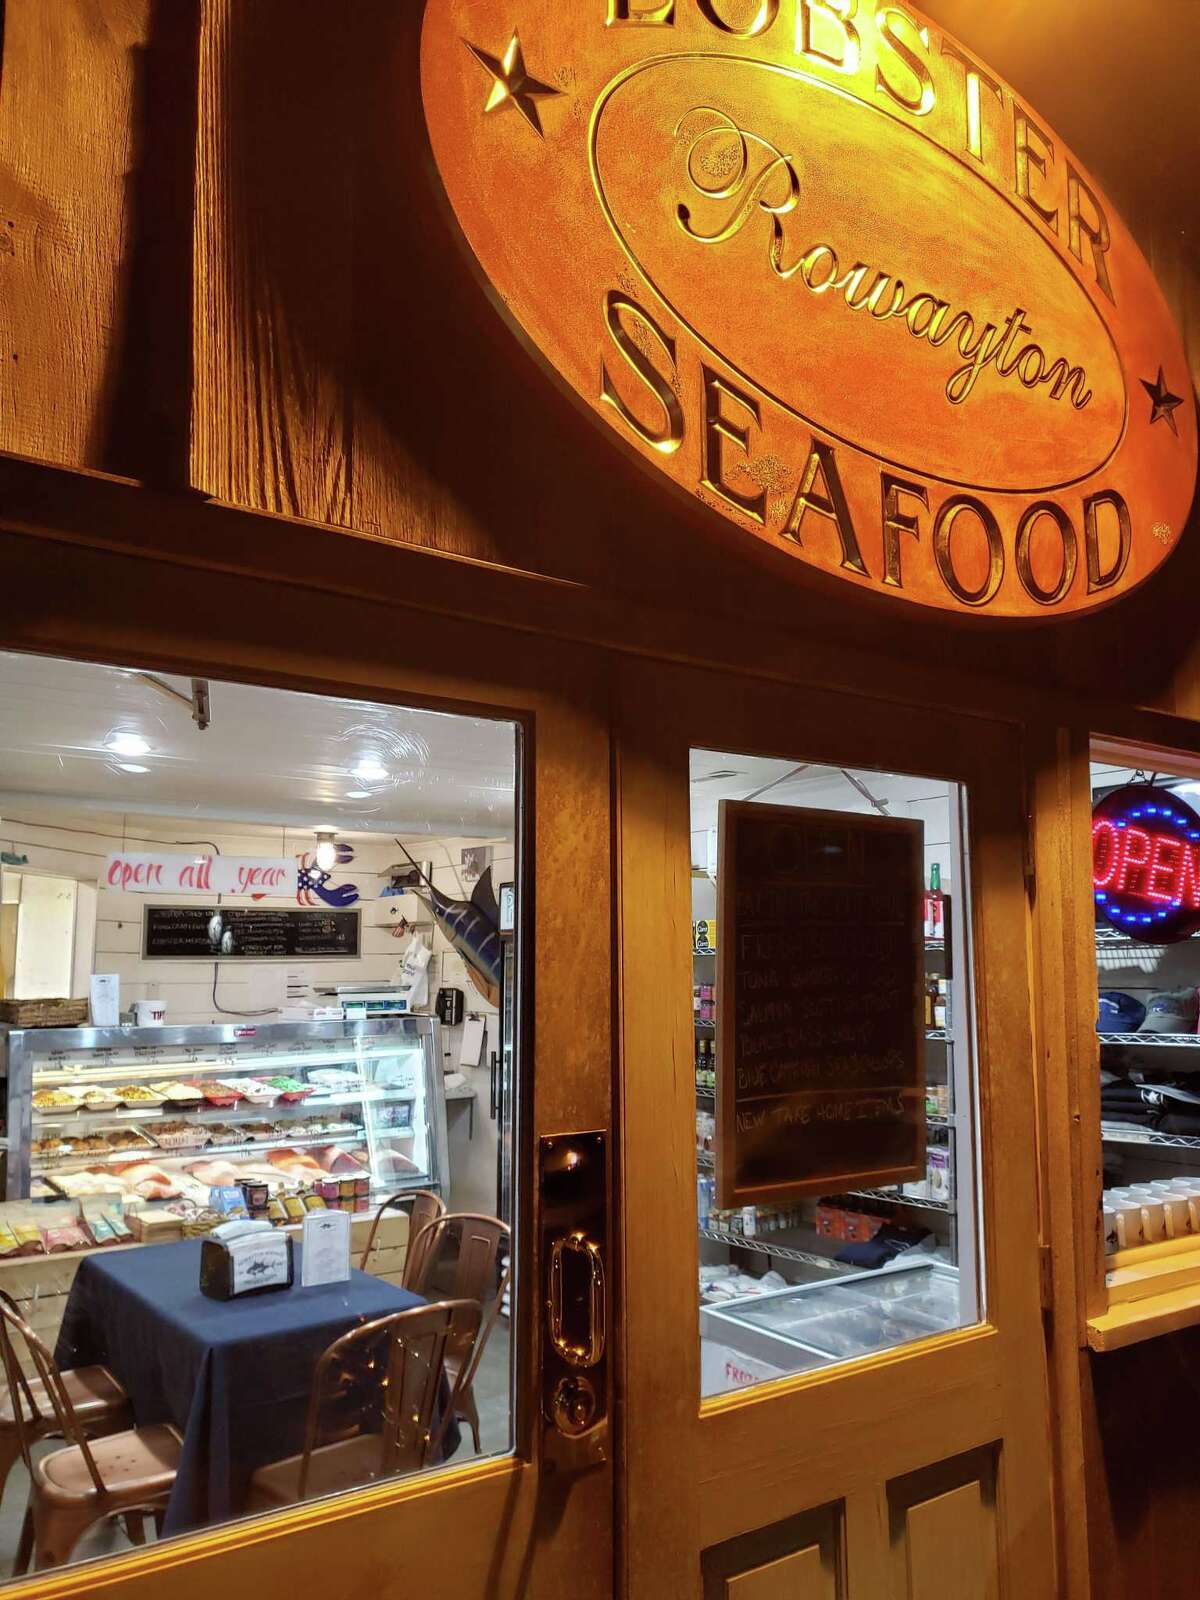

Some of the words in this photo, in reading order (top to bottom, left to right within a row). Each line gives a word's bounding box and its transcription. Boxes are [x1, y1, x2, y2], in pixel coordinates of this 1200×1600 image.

[604, 0, 1115, 304] BSTER
[674, 105, 1093, 410] Rowayton
[600, 289, 1132, 606] SEAFOOD
[238, 865, 286, 894] year
[1092, 819, 1200, 908] OPEN
[735, 1110, 766, 1134] NEW
[816, 1101, 852, 1121] HOME
